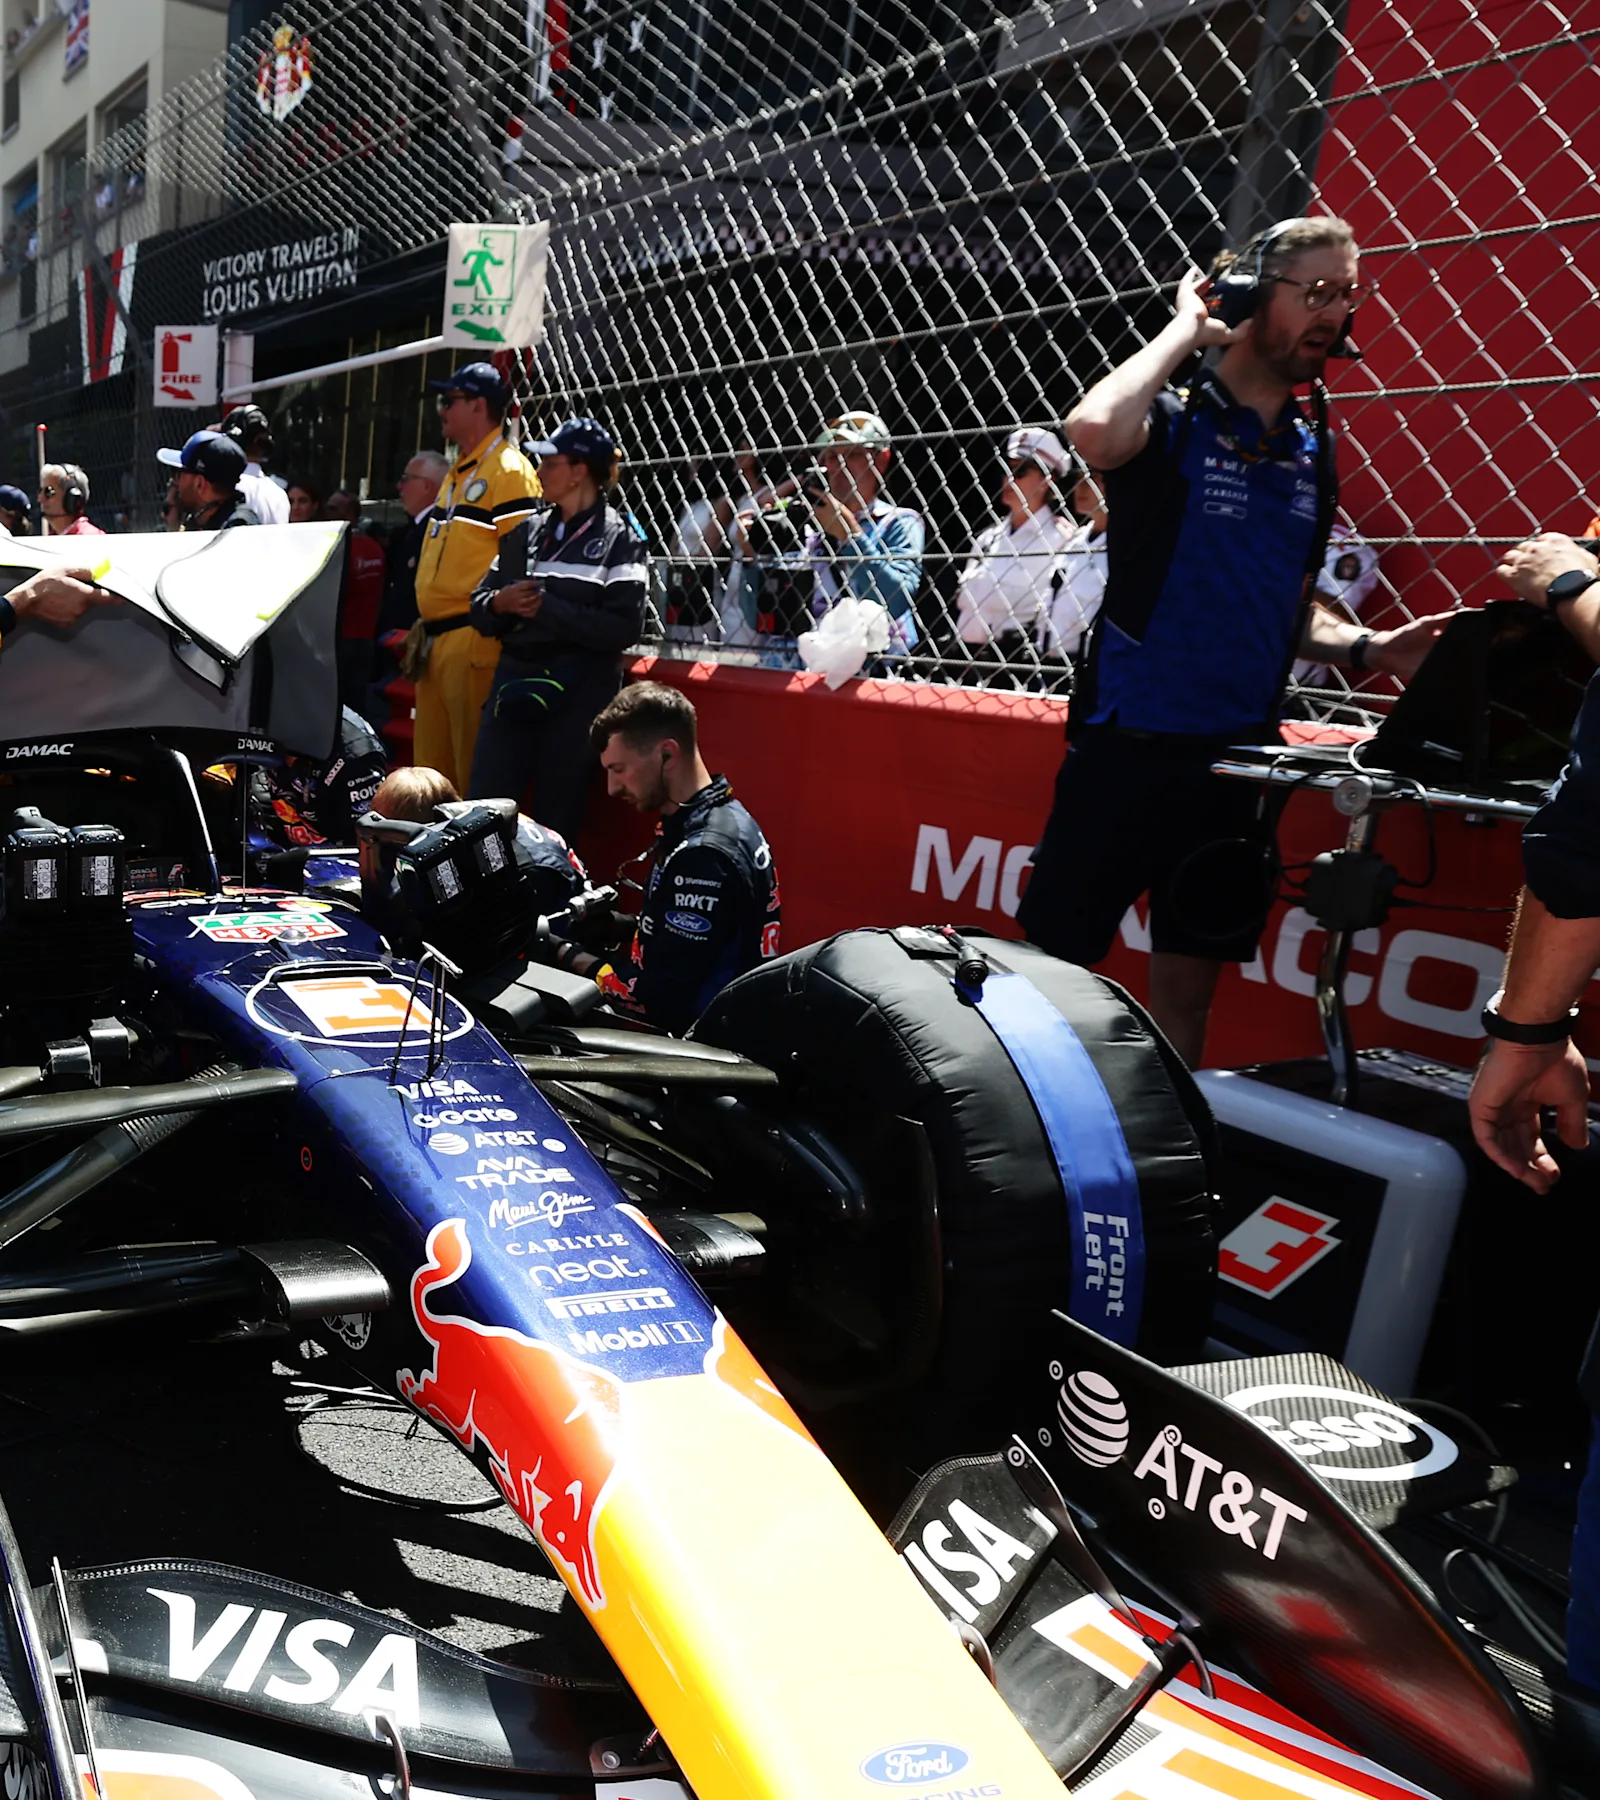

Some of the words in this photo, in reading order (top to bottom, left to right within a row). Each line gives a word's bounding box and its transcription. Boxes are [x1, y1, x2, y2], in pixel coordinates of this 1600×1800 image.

[203, 247, 267, 284] VICTORY
[271, 234, 339, 269] TRAVELS
[342, 226, 360, 254] IN
[202, 278, 261, 318] LOUIS
[266, 256, 359, 302] VUITTON
[451, 303, 512, 316] EXIT
[161, 374, 201, 384] FIRE
[5, 743, 75, 760] DAMAC
[237, 738, 275, 753] DAMAC
[675, 893, 719, 911] ROKT
[207, 913, 322, 927] TAG
[673, 912, 703, 930] Ford
[387, 1079, 480, 1099] VISA
[441, 1094, 504, 1105] INFINITE
[474, 1130, 536, 1149] AT&T
[476, 1156, 539, 1173] AVA
[456, 1168, 575, 1190] TRADE
[489, 1198, 537, 1230] Maui
[538, 1191, 592, 1228] Jim
[505, 1233, 630, 1256] CARLYLE
[1083, 1210, 1108, 1293] Left
[529, 1255, 649, 1287] neat.
[1105, 1213, 1130, 1318] Front
[544, 1287, 676, 1319] PIRELLI
[570, 1323, 668, 1355] Mobil
[1133, 1425, 1308, 1561] AT&T
[901, 1498, 1035, 1624] ISA
[145, 1587, 421, 1728] VISA
[884, 1747, 953, 1781] Ford
